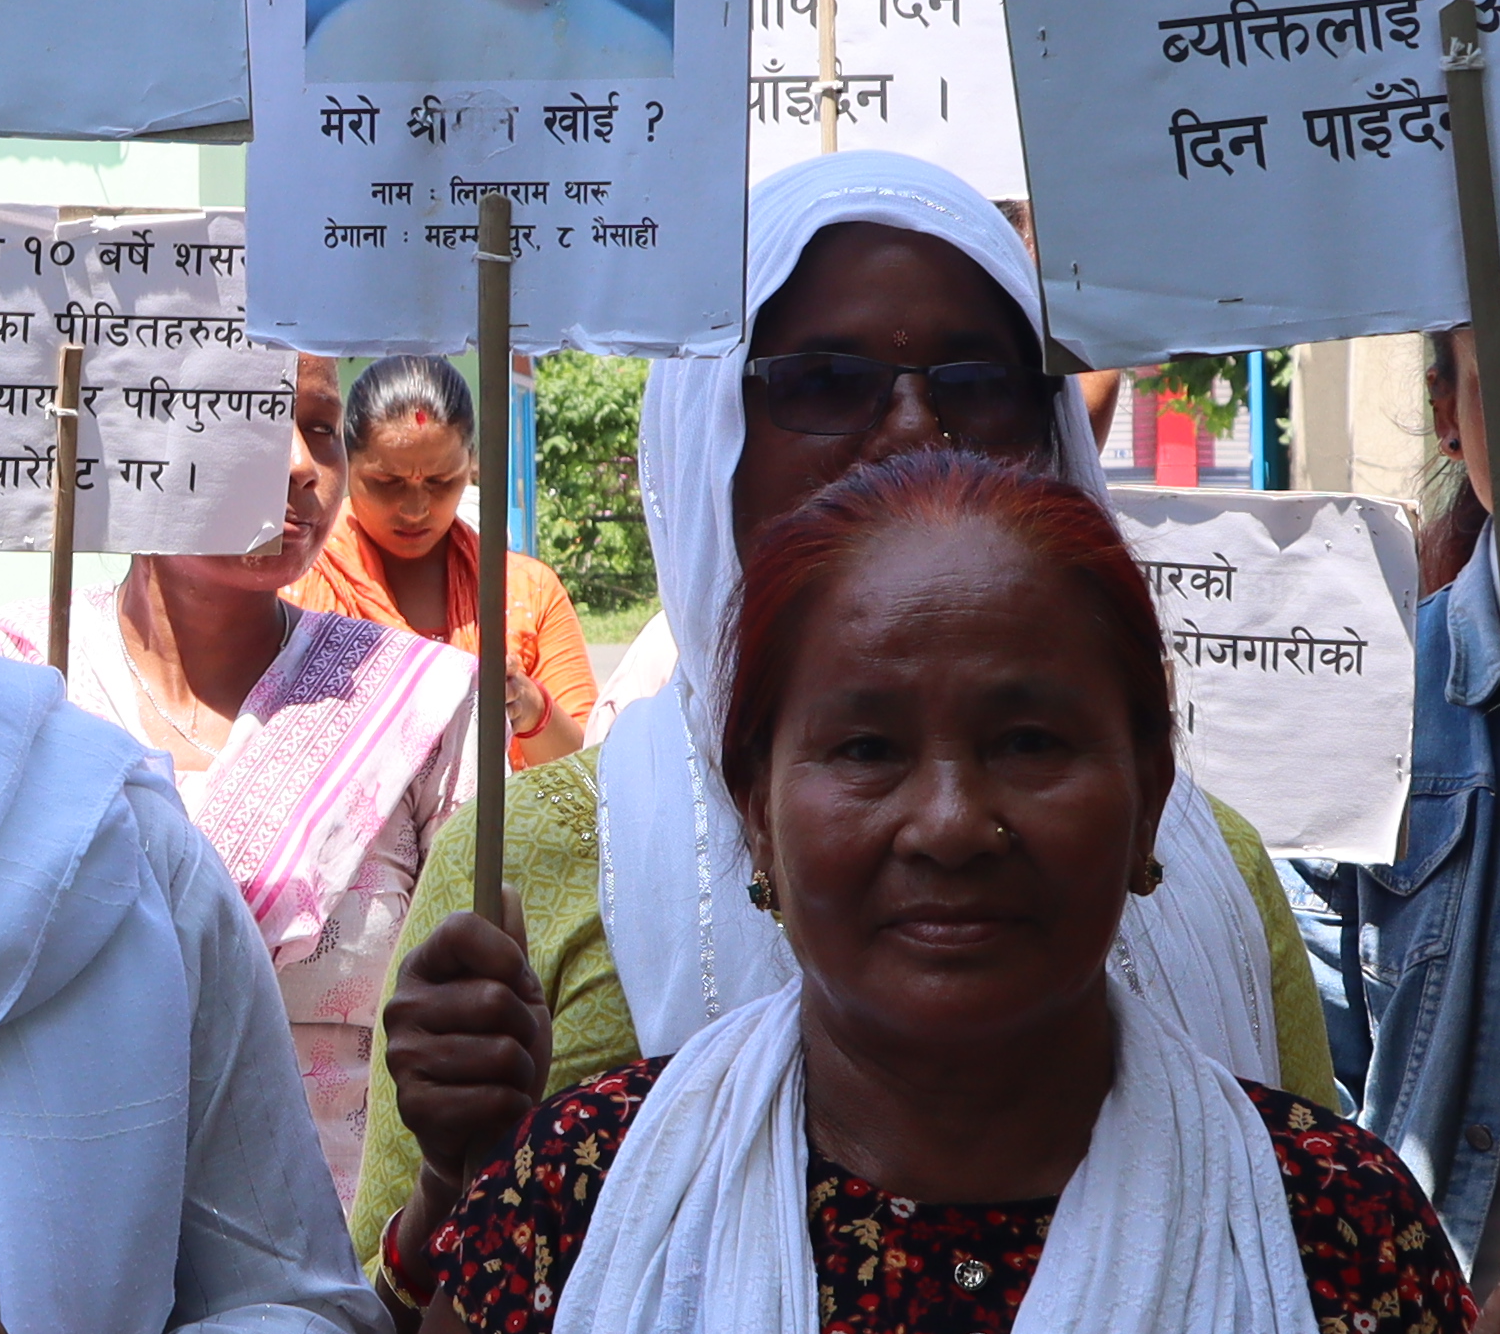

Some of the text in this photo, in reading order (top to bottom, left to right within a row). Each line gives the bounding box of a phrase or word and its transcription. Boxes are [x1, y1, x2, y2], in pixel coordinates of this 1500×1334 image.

[320, 96, 380, 145] मेरो
[543, 91, 619, 145] खोई
[645, 100, 664, 144] ?
[1169, 108, 1268, 179] दिन
[371, 181, 414, 205] नाम
[24, 235, 76, 275] १०
[99, 230, 155, 275] बर्षे
[173, 242, 246, 276] शस
[324, 218, 388, 250] ठेगाना
[81, 386, 104, 419] र
[123, 376, 296, 433] परिपुरणको
[118, 459, 169, 492] गर
[1173, 618, 1368, 676] रोजगारीको
